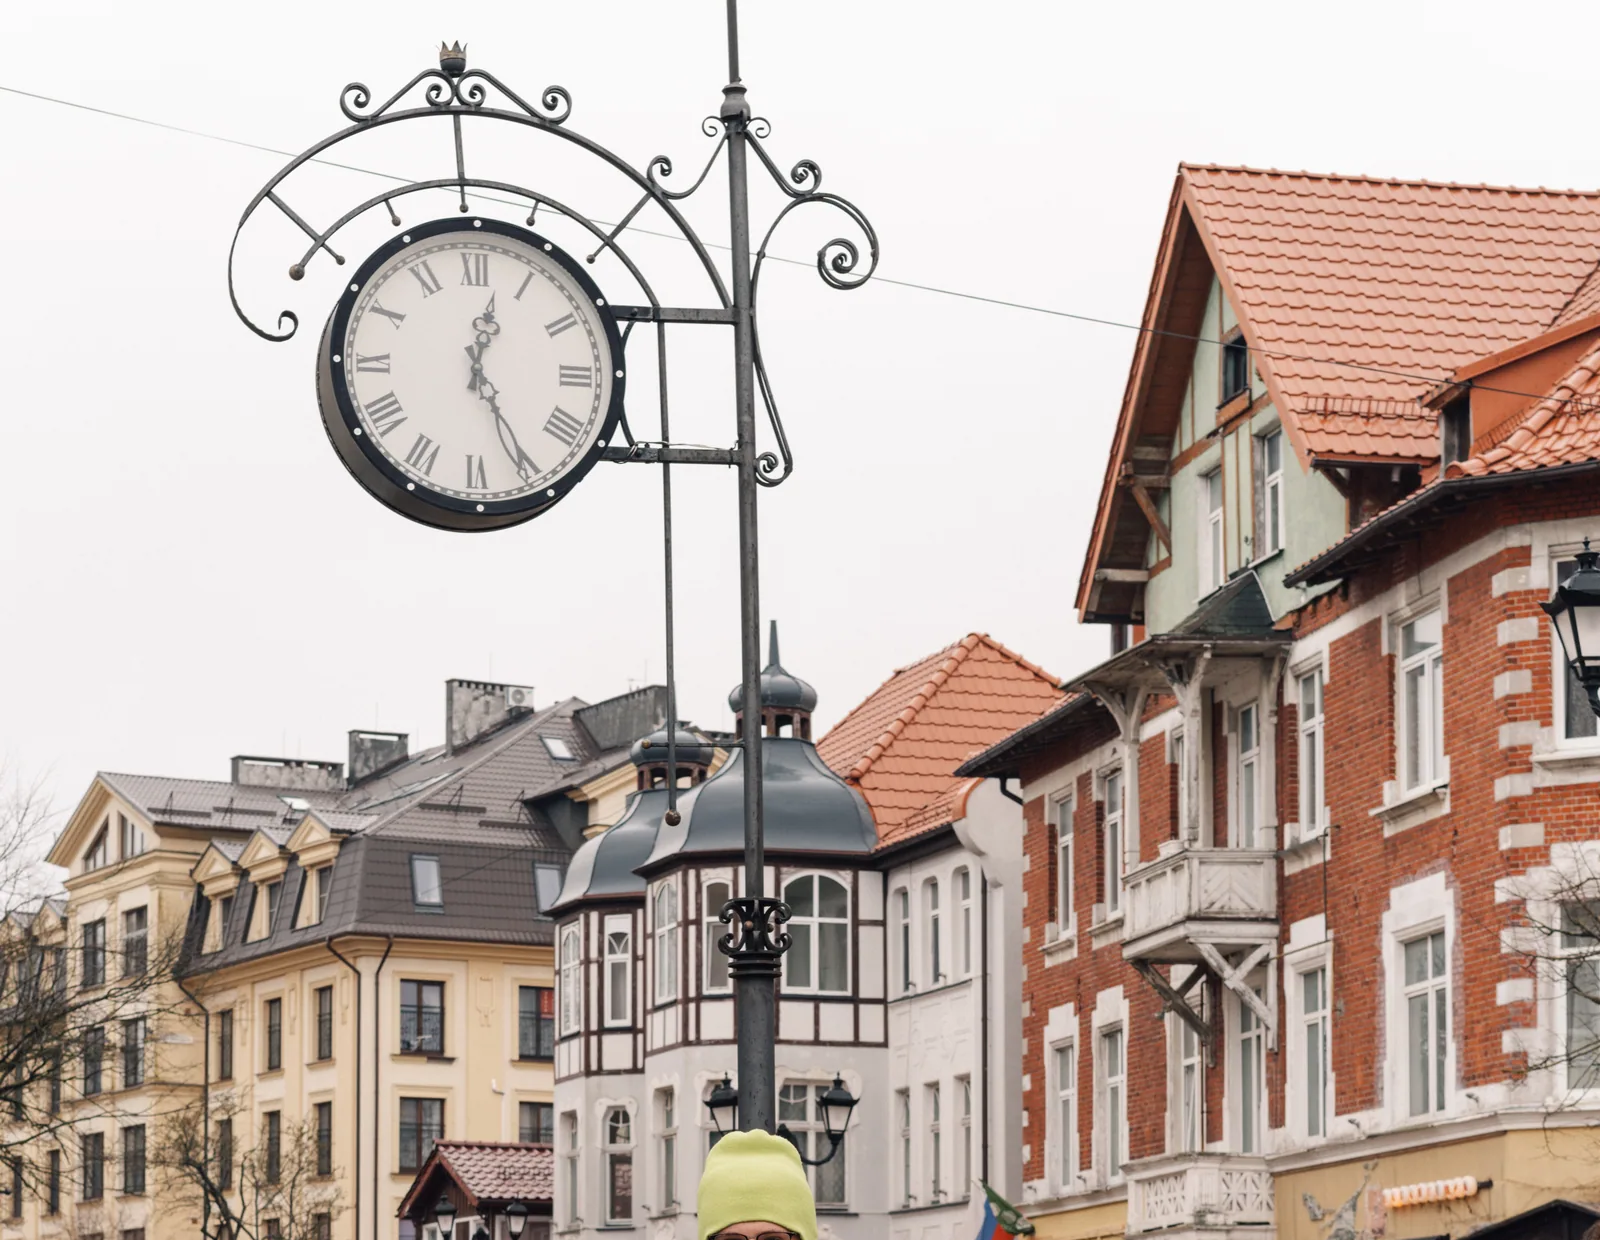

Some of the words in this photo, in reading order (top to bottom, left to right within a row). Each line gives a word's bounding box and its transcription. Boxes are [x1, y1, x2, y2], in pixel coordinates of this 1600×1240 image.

[407, 259, 444, 299] XI
[460, 252, 490, 287] XII
[513, 270, 536, 301] I
[368, 298, 407, 331] X
[544, 312, 580, 338] II
[355, 352, 391, 375] IX
[559, 364, 593, 389] III
[363, 390, 409, 440] VIII
[542, 405, 586, 449] IIII
[404, 433, 442, 478] VII
[465, 454, 489, 490] VI
